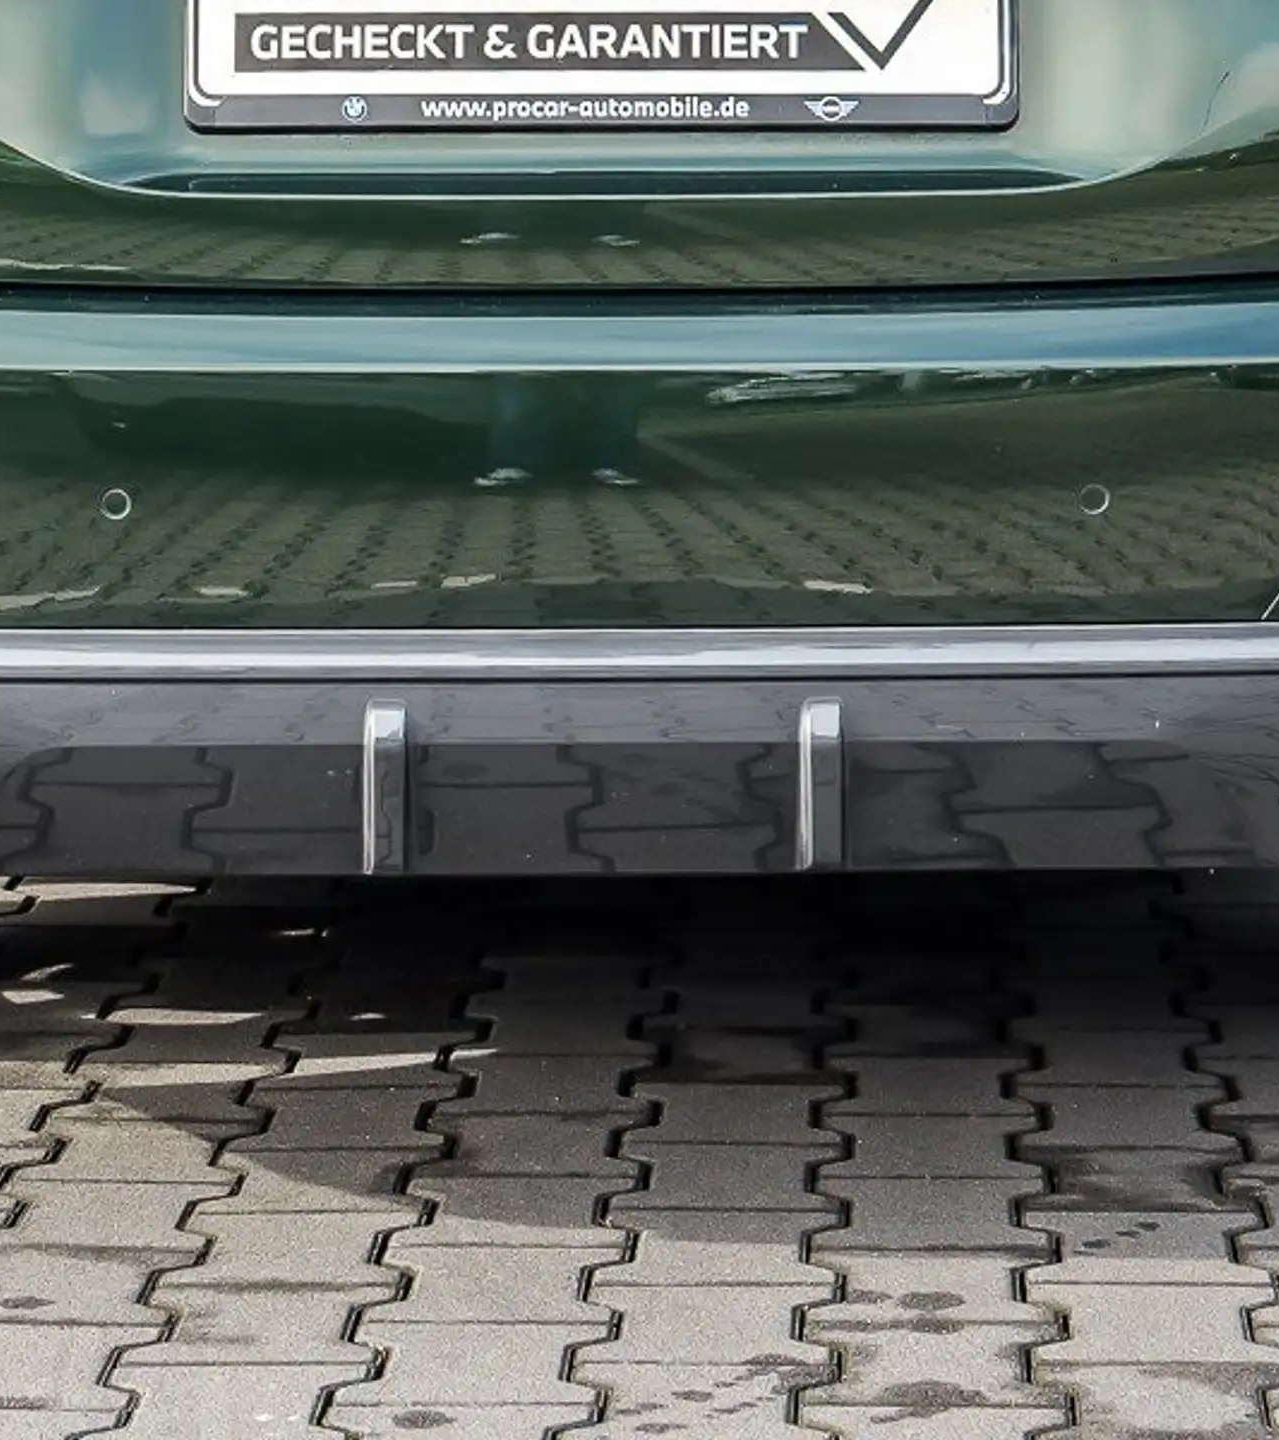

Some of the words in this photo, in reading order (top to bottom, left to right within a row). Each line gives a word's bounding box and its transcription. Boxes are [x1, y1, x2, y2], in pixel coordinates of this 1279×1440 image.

[250, 23, 475, 60] GECHECKT
[483, 23, 518, 60] &
[526, 22, 809, 60] GARANTIERT
[420, 95, 751, 122] www.procar-automobile.de
